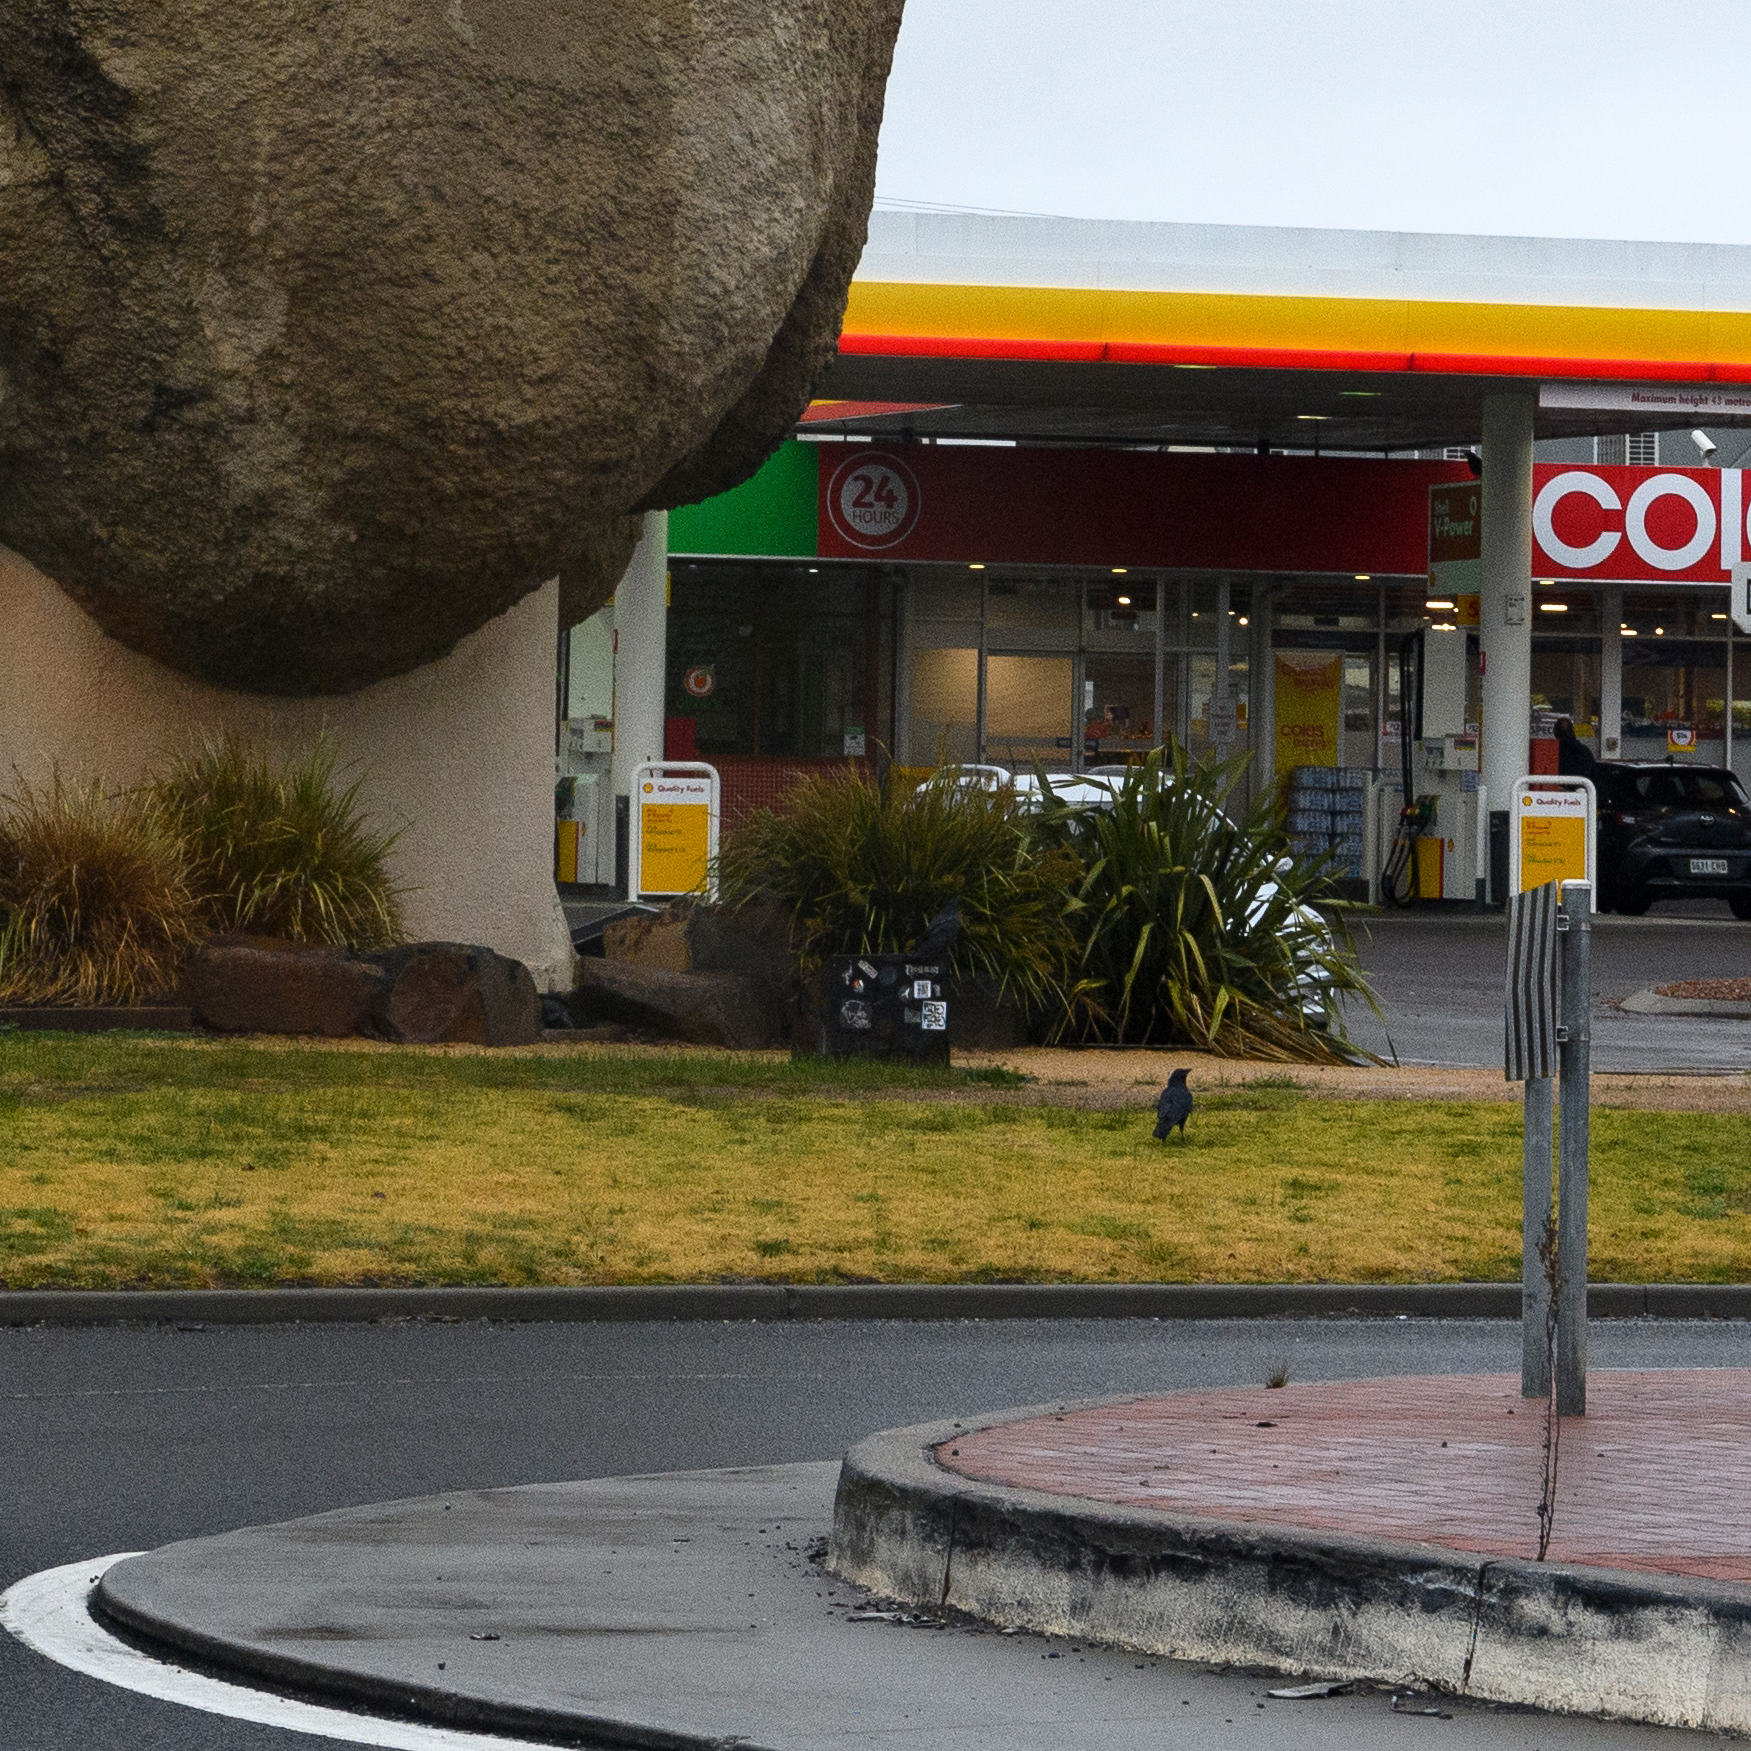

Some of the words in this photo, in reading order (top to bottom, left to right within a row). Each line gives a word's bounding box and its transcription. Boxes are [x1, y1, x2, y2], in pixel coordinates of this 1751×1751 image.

[1631, 392, 1677, 404] Maximum
[1678, 394, 1709, 407] height
[851, 474, 898, 509] 24
[851, 510, 900, 525] HOURS
[1434, 516, 1474, 538] V-Power
[657, 785, 685, 794] Quality
[1536, 798, 1563, 808] Quality
